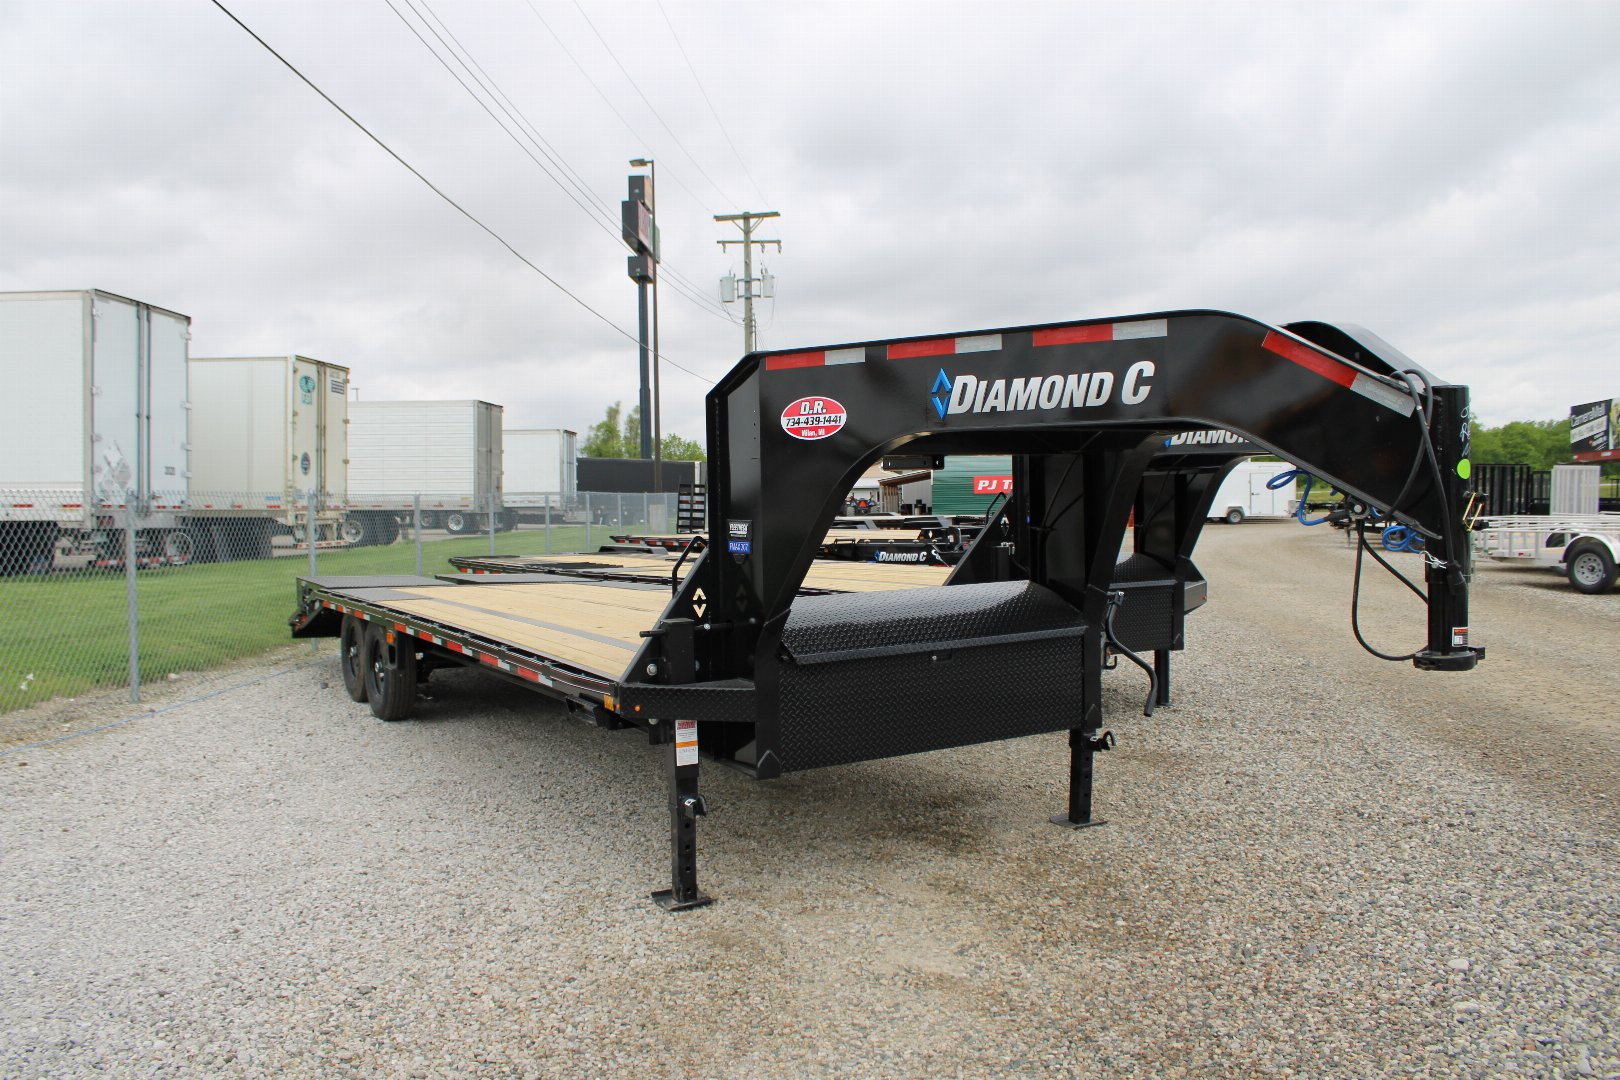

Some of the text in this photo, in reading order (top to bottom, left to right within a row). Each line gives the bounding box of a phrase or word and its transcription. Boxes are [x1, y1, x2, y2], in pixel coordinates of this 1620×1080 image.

[1122, 361, 1155, 405] C
[800, 400, 827, 414] D.R.
[786, 415, 842, 427] 734-439-1441
[977, 479, 1012, 490] PJ T
[919, 551, 928, 562] C
